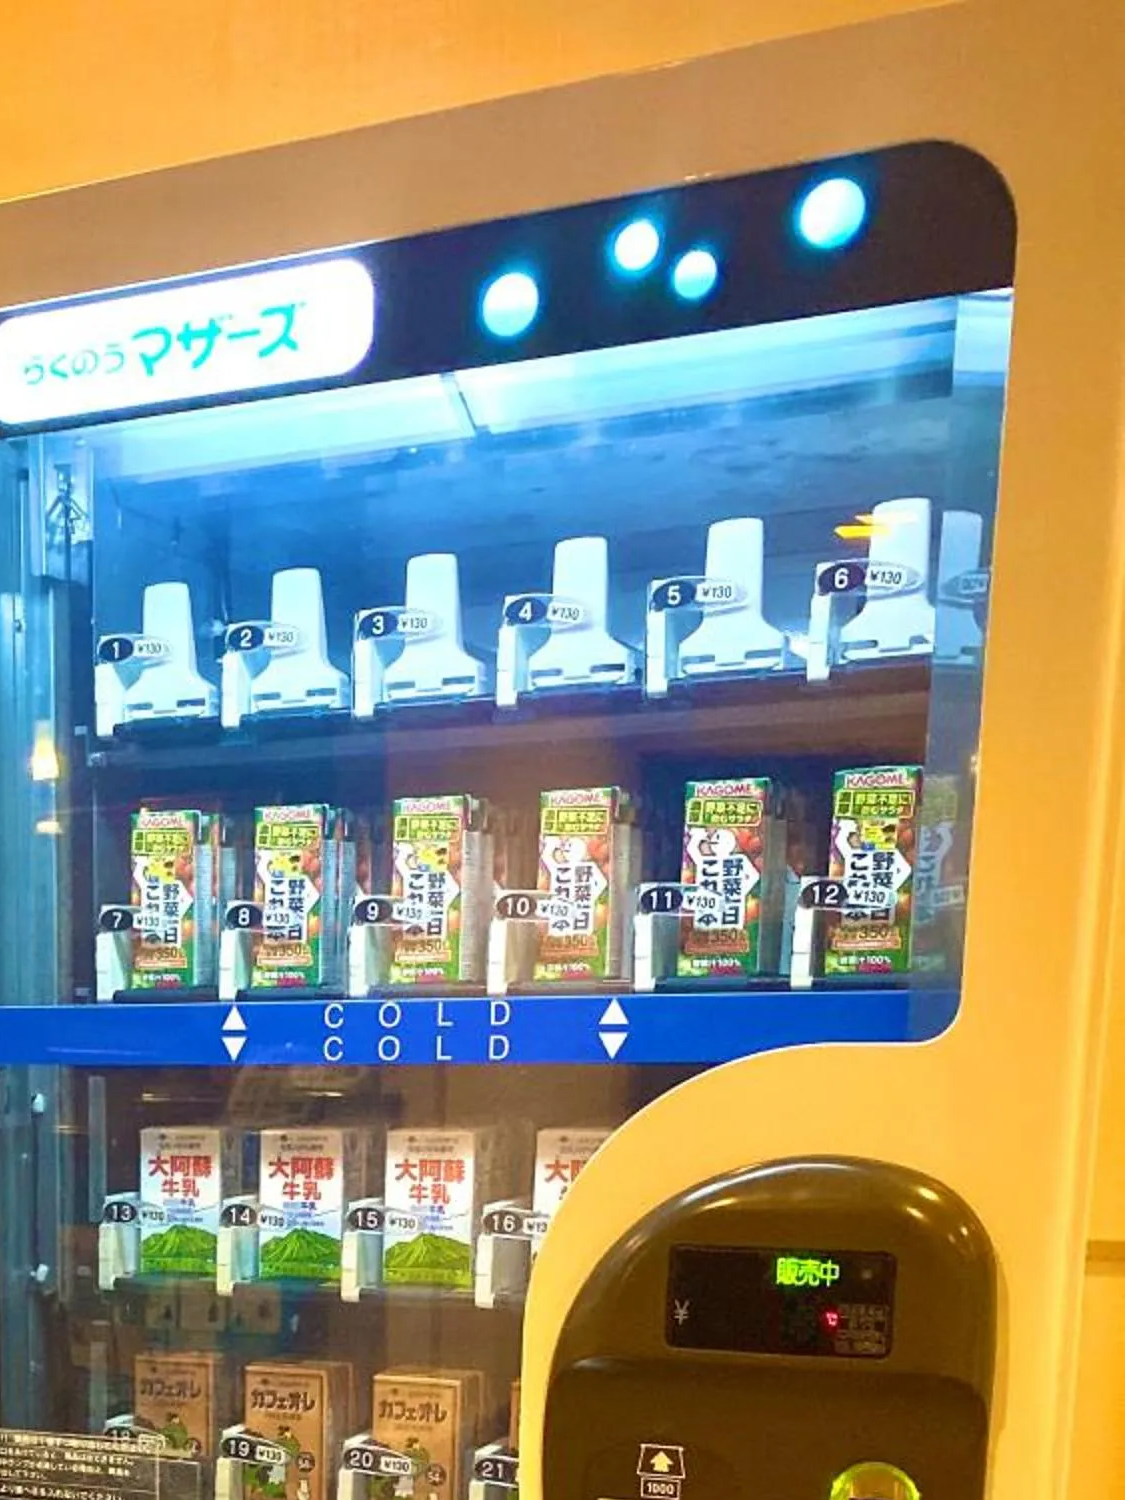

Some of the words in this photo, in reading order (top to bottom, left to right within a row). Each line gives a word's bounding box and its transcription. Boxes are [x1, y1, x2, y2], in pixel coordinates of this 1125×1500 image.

[24, 300, 306, 386] らくのうマザーズ
[833, 567, 849, 588] 6
[869, 569, 902, 585] ¥130
[668, 585, 681, 606] 5
[701, 585, 733, 600] ¥130
[519, 602, 532, 621] 4
[551, 605, 579, 621] ¥130
[372, 616, 385, 636] 3
[400, 616, 428, 630] ¥130
[240, 629, 253, 648] 2
[111, 640, 123, 659] 1
[696, 783, 754, 797] KAGOME
[846, 774, 907, 788] KAGOME
[649, 891, 672, 909] 11
[687, 894, 716, 909] ¥130
[812, 884, 839, 904] 12
[853, 888, 885, 903] ¥130
[238, 908, 250, 925] 8
[367, 902, 378, 920] 9
[506, 899, 530, 915] 10
[111, 912, 120, 928] 7
[324, 1001, 511, 1029] COLD
[323, 1034, 511, 1062] COLD
[148, 1154, 212, 1178] 大阿蘇
[268, 1156, 335, 1180] 大阿蘇
[394, 1158, 467, 1184] 大阿蘇
[161, 1178, 200, 1198] 牛乳
[282, 1180, 323, 1201] 牛乳
[408, 1183, 451, 1205] 牛乳
[112, 1205, 131, 1220] 13
[228, 1208, 251, 1224] 14
[356, 1211, 379, 1228] 15
[492, 1215, 516, 1232] 16
[526, 1222, 548, 1233] ¥13
[776, 1257, 840, 1288] 販売中
[250, 1388, 316, 1412] カフェオレ
[377, 1399, 448, 1423] カフェオレ
[229, 1439, 250, 1457] 19
[349, 1451, 373, 1468] 20
[481, 1461, 505, 1479] 21
[646, 1482, 675, 1495] 1000
